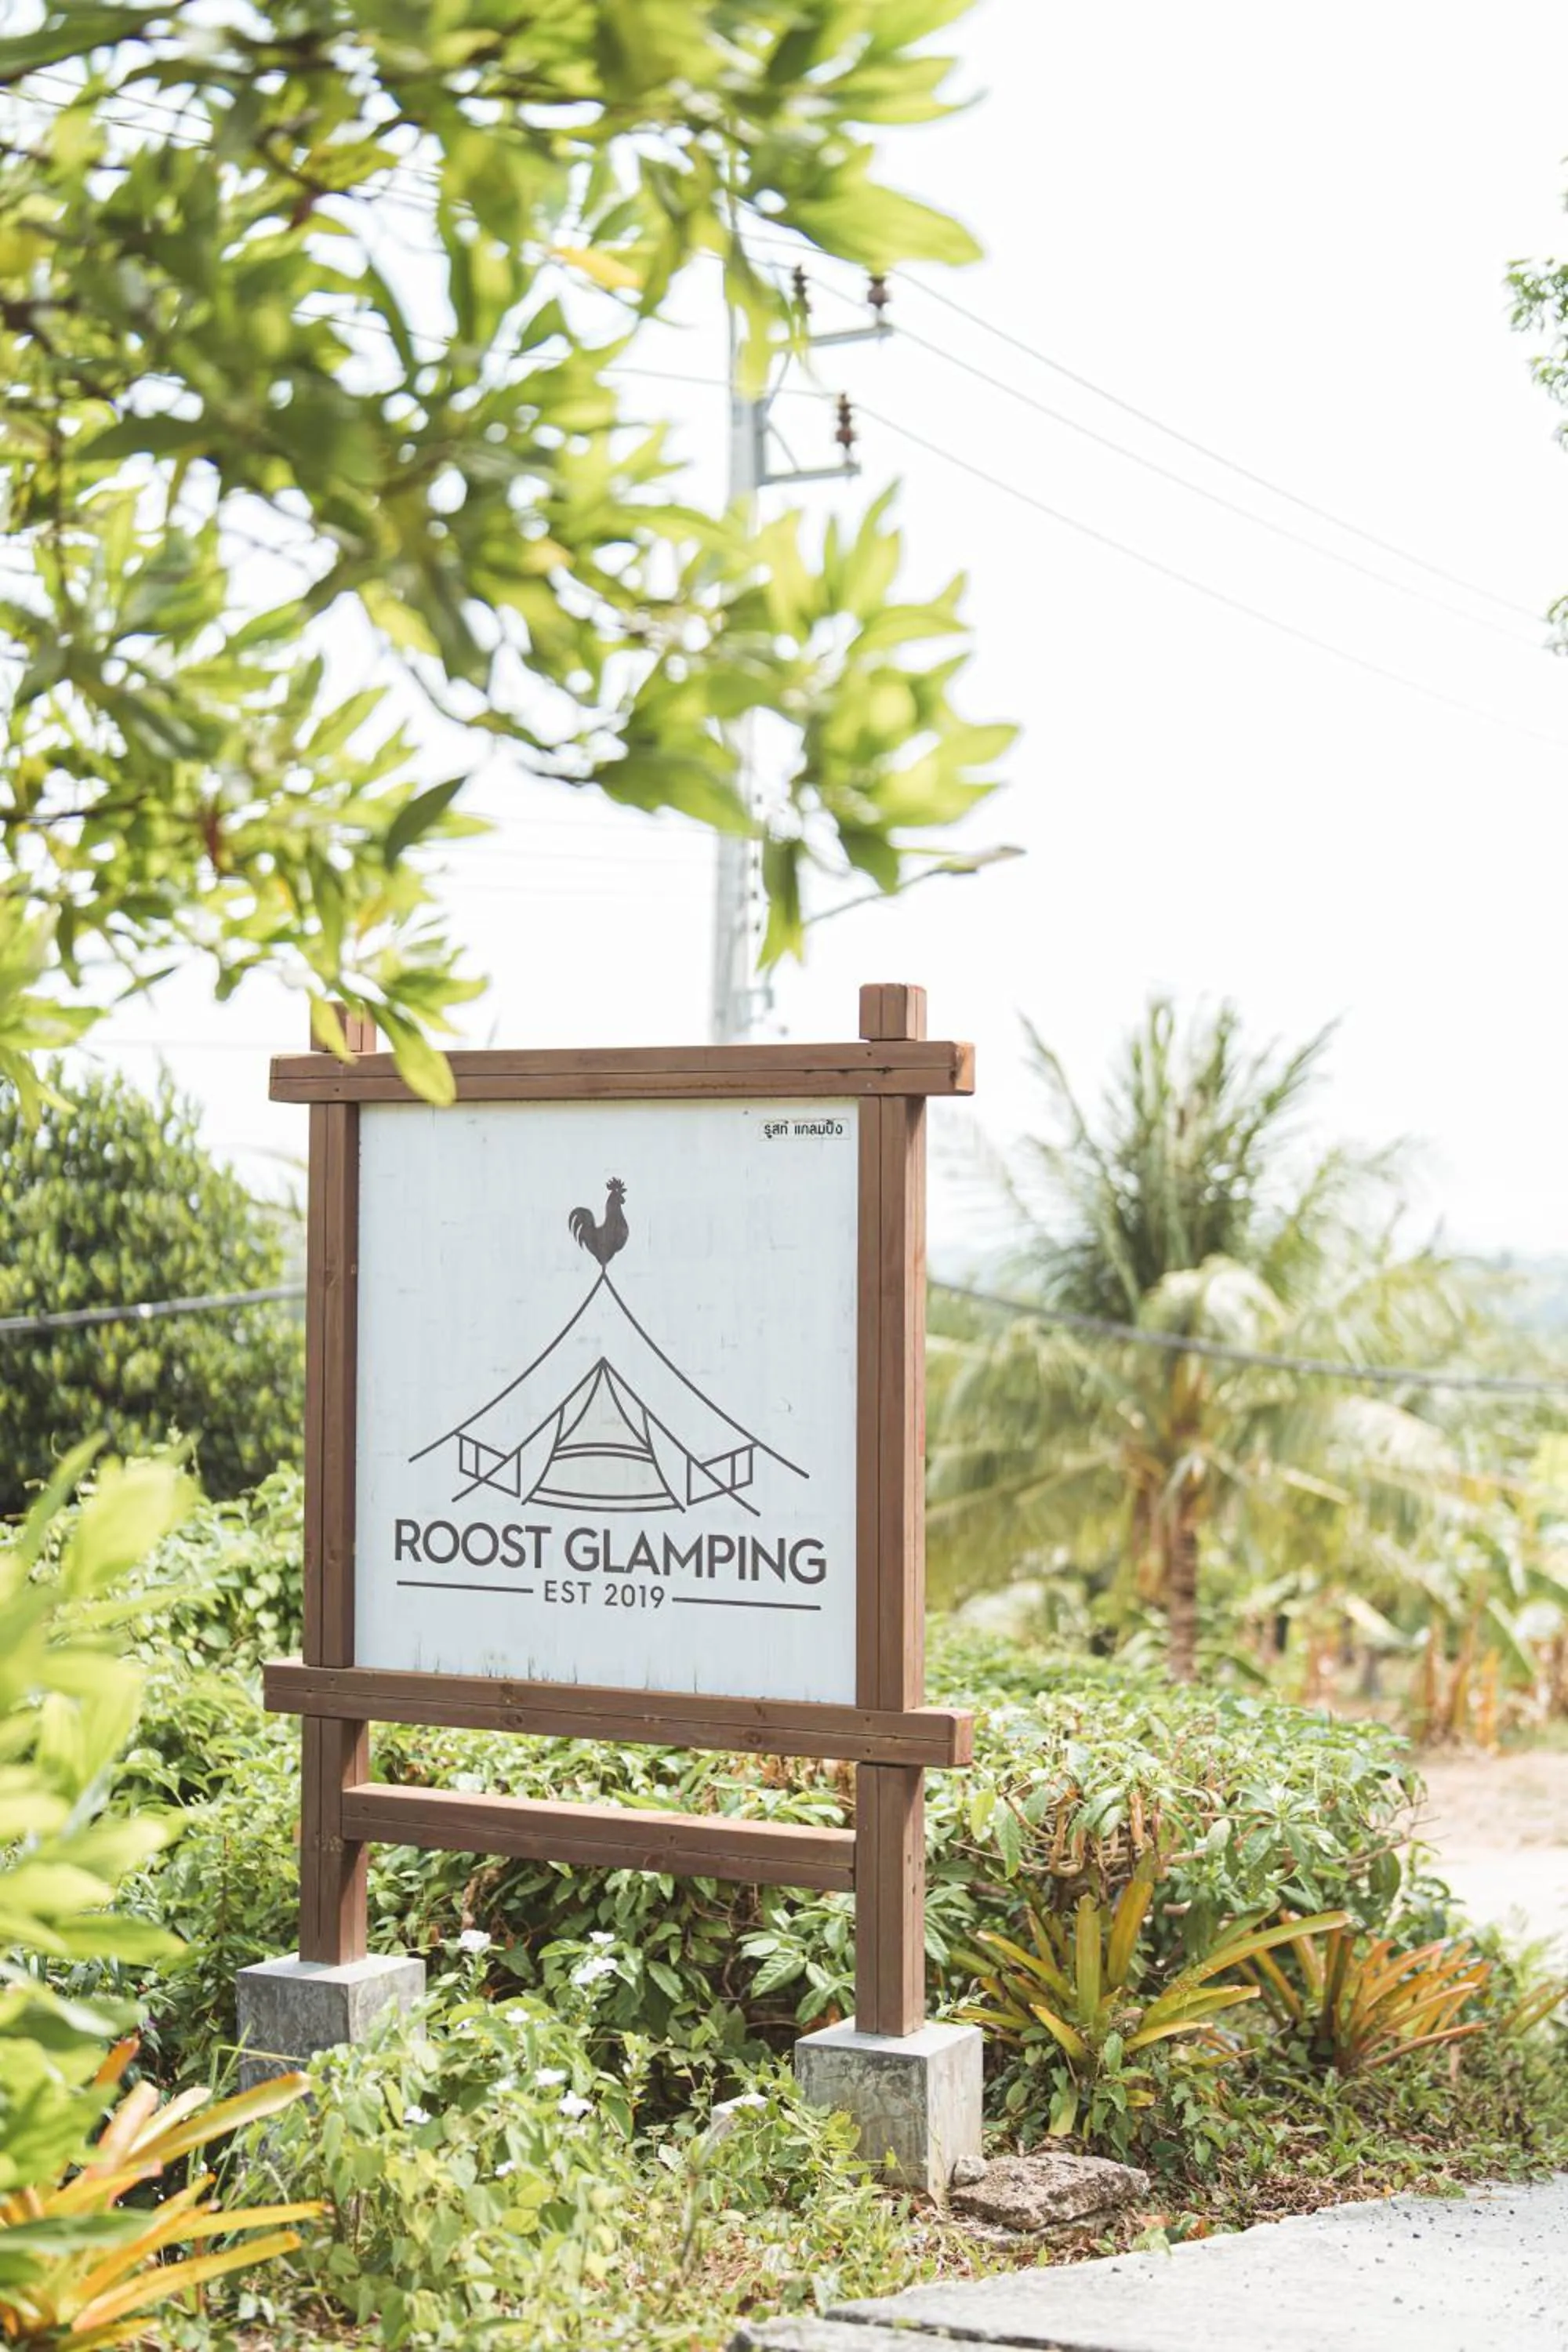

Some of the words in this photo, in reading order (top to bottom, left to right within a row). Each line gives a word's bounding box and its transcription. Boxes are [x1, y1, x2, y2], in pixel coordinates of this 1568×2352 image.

[394, 1519, 552, 1569] ROOST
[564, 1526, 826, 1584] GLAMPING
[544, 1580, 592, 1604] EST
[604, 1583, 665, 1609] 2019
